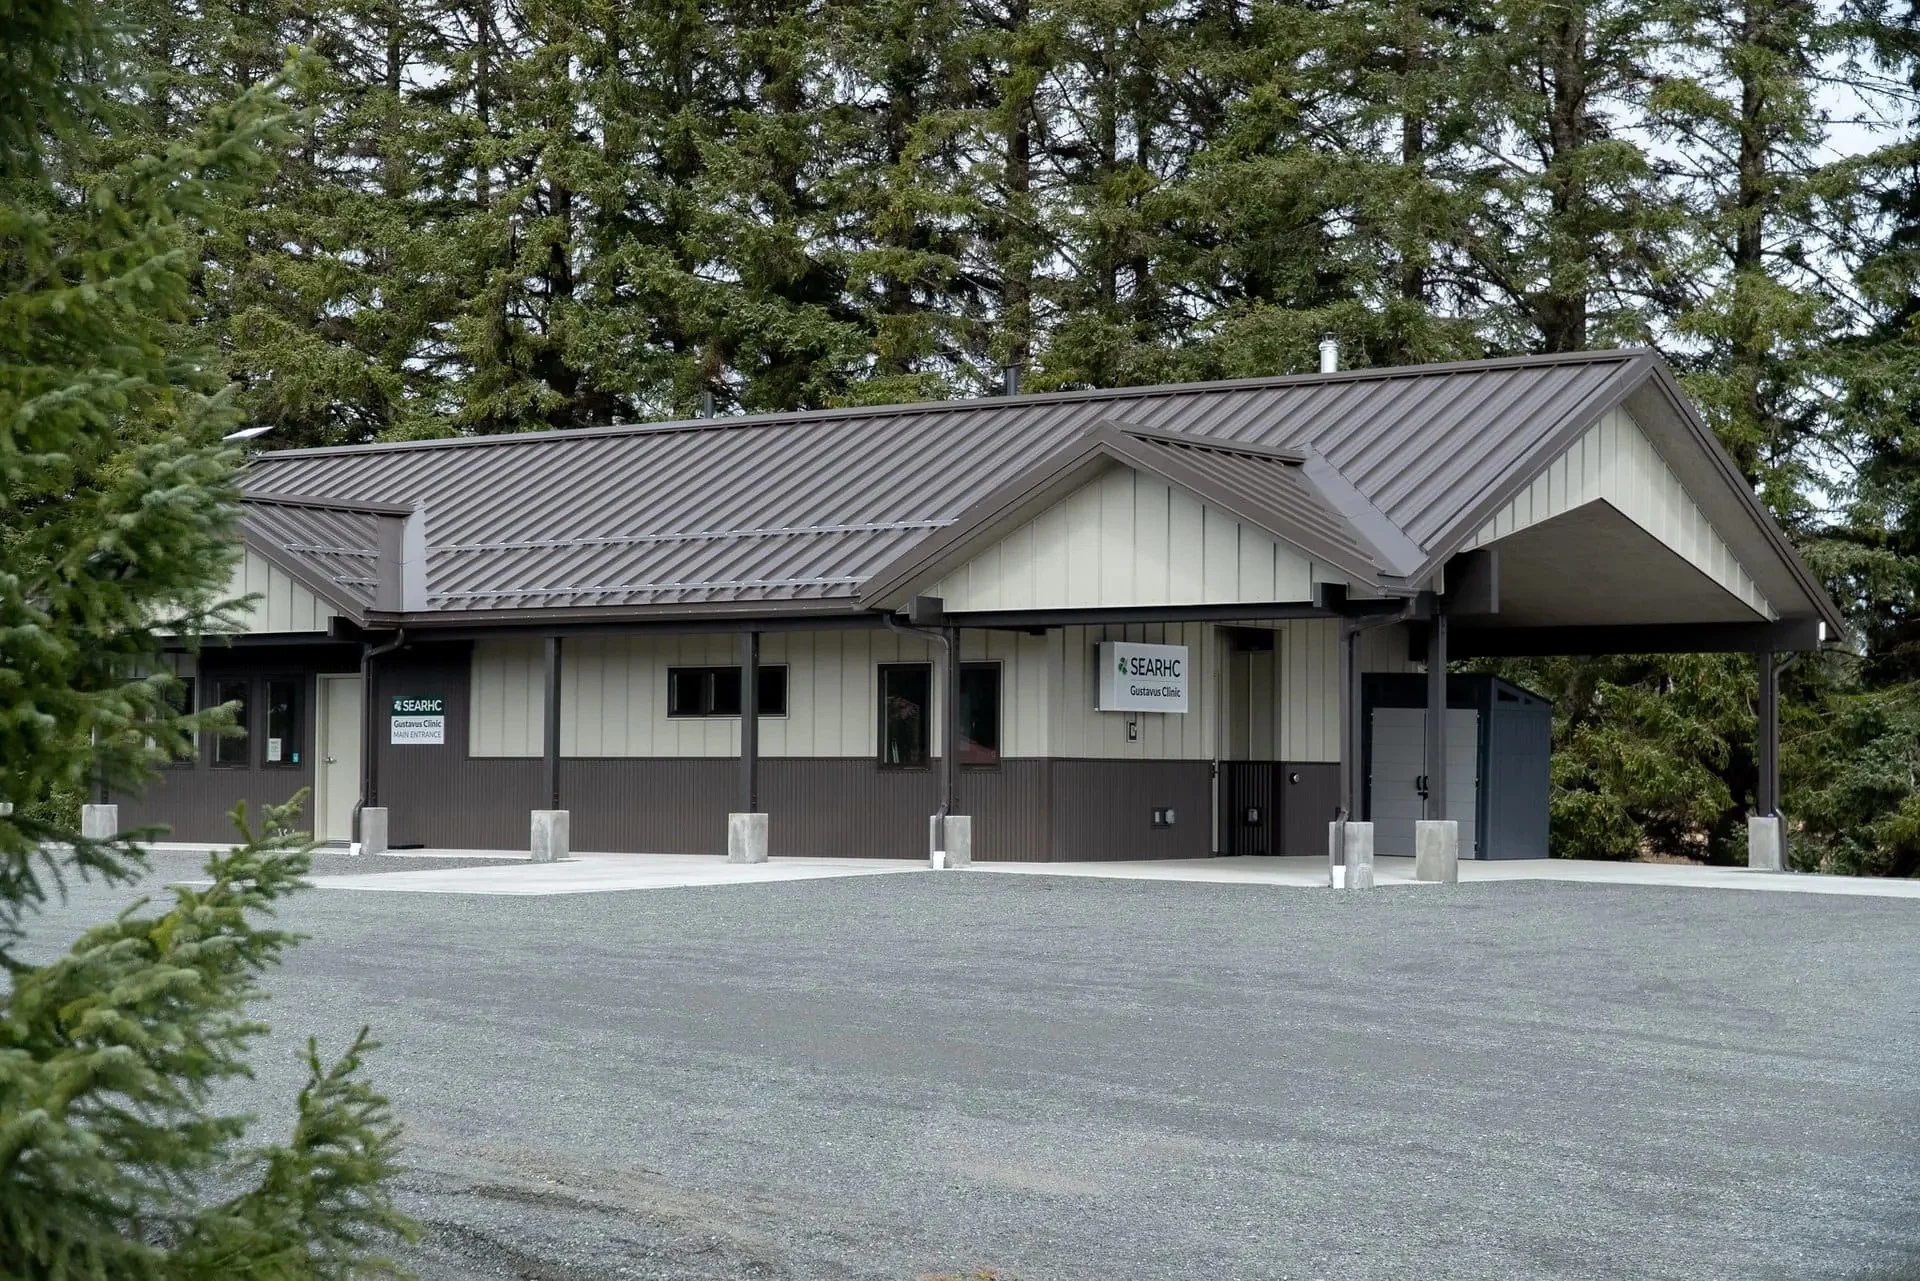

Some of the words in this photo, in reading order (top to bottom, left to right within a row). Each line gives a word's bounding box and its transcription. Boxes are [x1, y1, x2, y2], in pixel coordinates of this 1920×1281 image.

[1131, 657, 1180, 677] SEARHC
[1130, 685, 1161, 697] Gustavus
[1162, 686, 1181, 698] Clinic
[403, 700, 442, 711] SEARHC
[394, 720, 422, 728] Gustavus
[423, 720, 441, 728] Clinic
